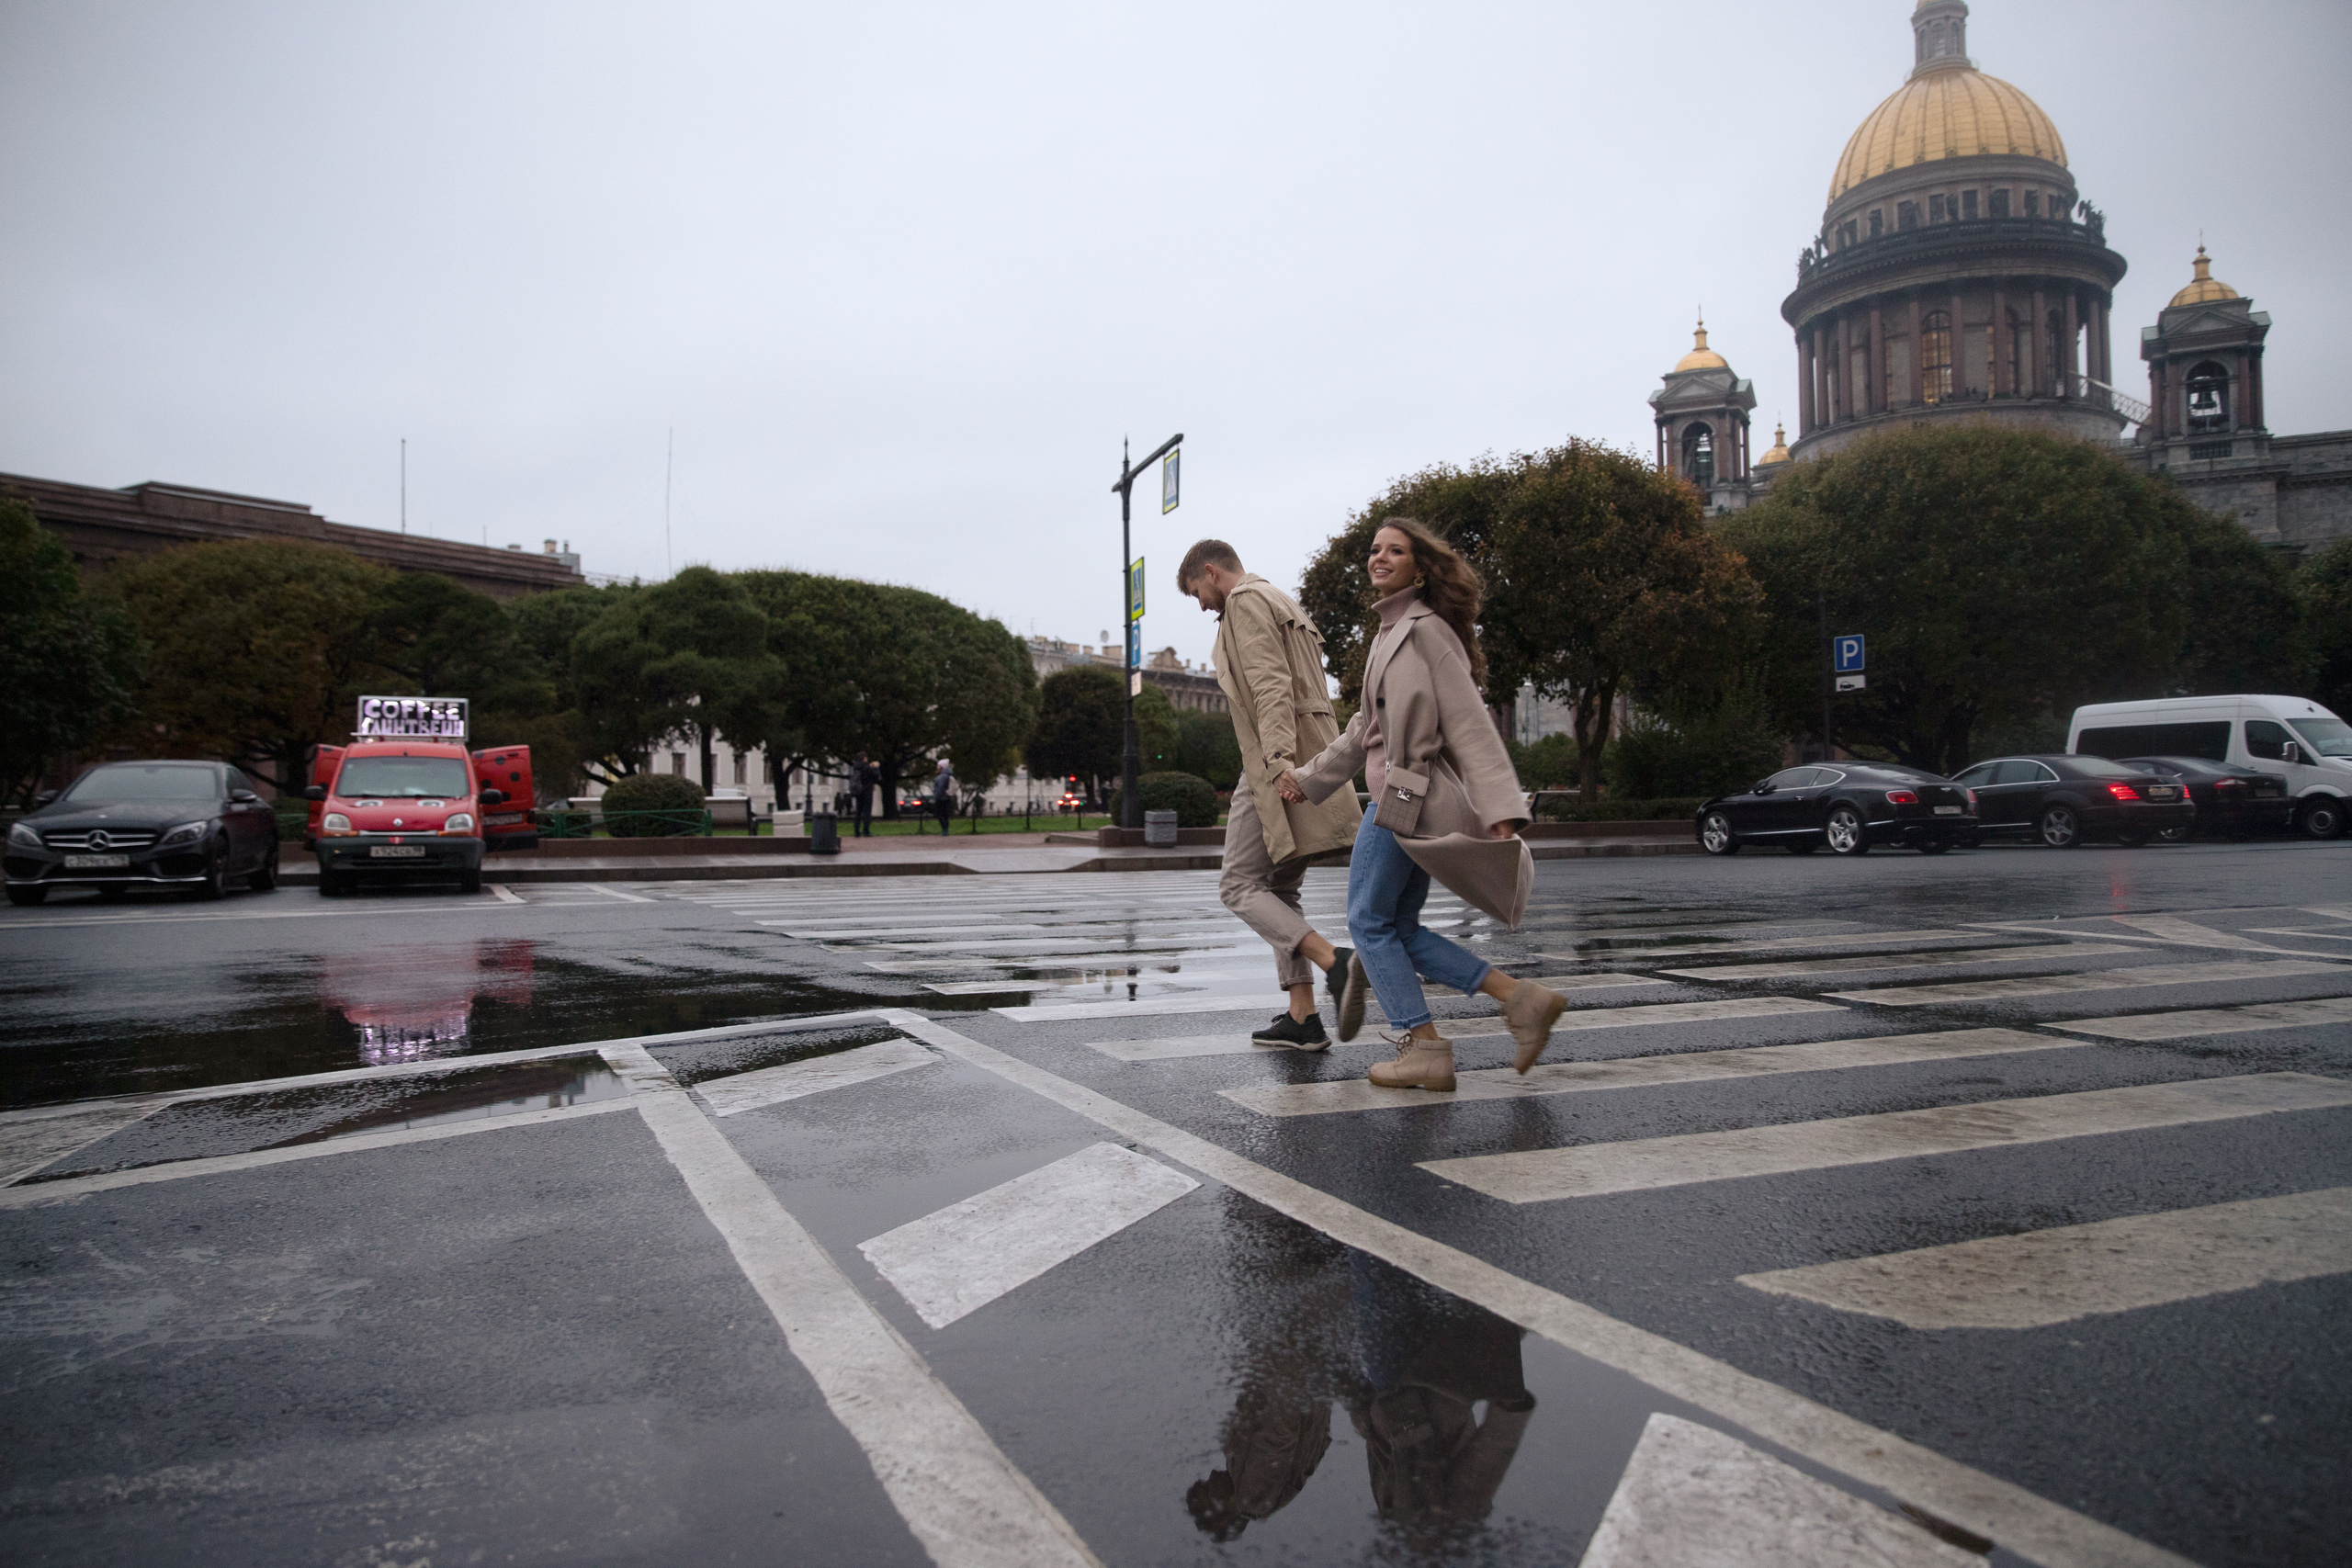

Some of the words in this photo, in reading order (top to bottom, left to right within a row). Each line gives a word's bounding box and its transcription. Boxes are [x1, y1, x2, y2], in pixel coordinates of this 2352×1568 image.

[1134, 628, 1139, 661] P
[1843, 639, 1859, 668] P
[364, 699, 459, 720] COFFEE
